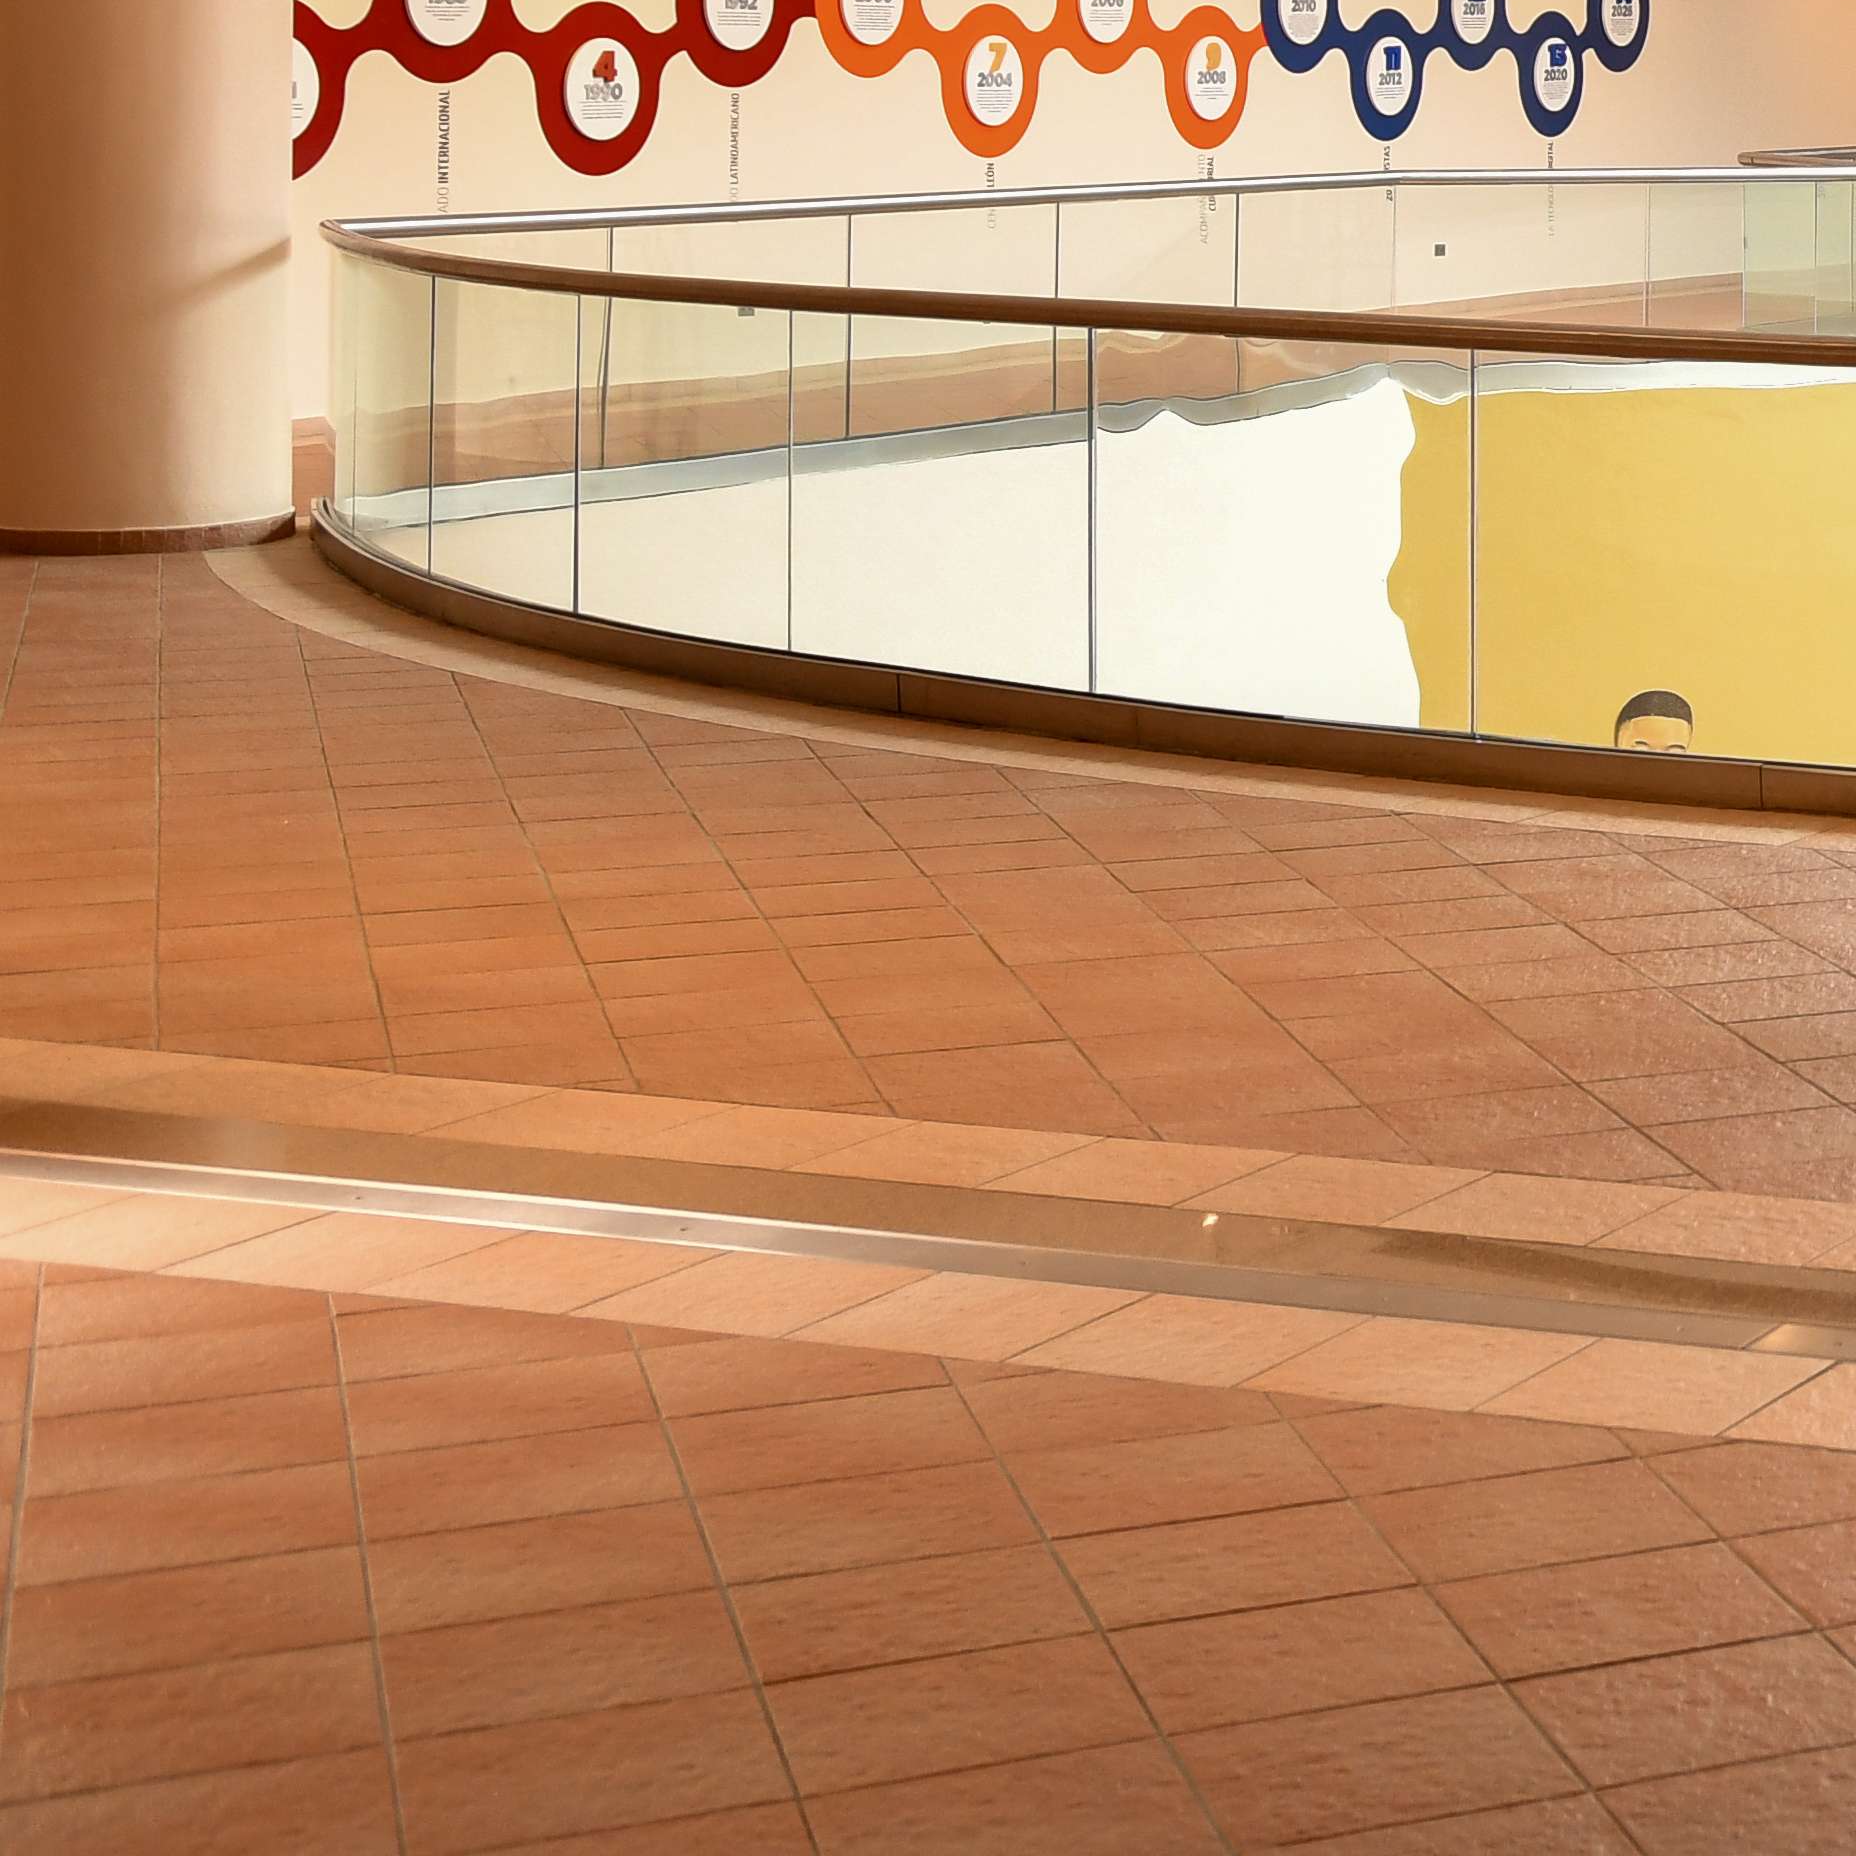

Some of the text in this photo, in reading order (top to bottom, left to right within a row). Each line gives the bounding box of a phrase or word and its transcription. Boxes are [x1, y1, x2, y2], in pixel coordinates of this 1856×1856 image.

[1291, 0, 1317, 12] 2010
[592, 50, 618, 82] 4
[988, 43, 1007, 73] 7
[1206, 42, 1222, 70] 9
[1383, 46, 1402, 71] 11
[1548, 43, 1568, 67] 13
[977, 72, 1013, 87] 2004
[1197, 71, 1226, 84] 2008
[1379, 72, 1402, 86] 2012
[1544, 69, 1568, 82] 2020
[584, 84, 623, 102] 1990
[438, 89, 451, 183] INTERNACIONAL
[985, 162, 995, 188] LEÓN
